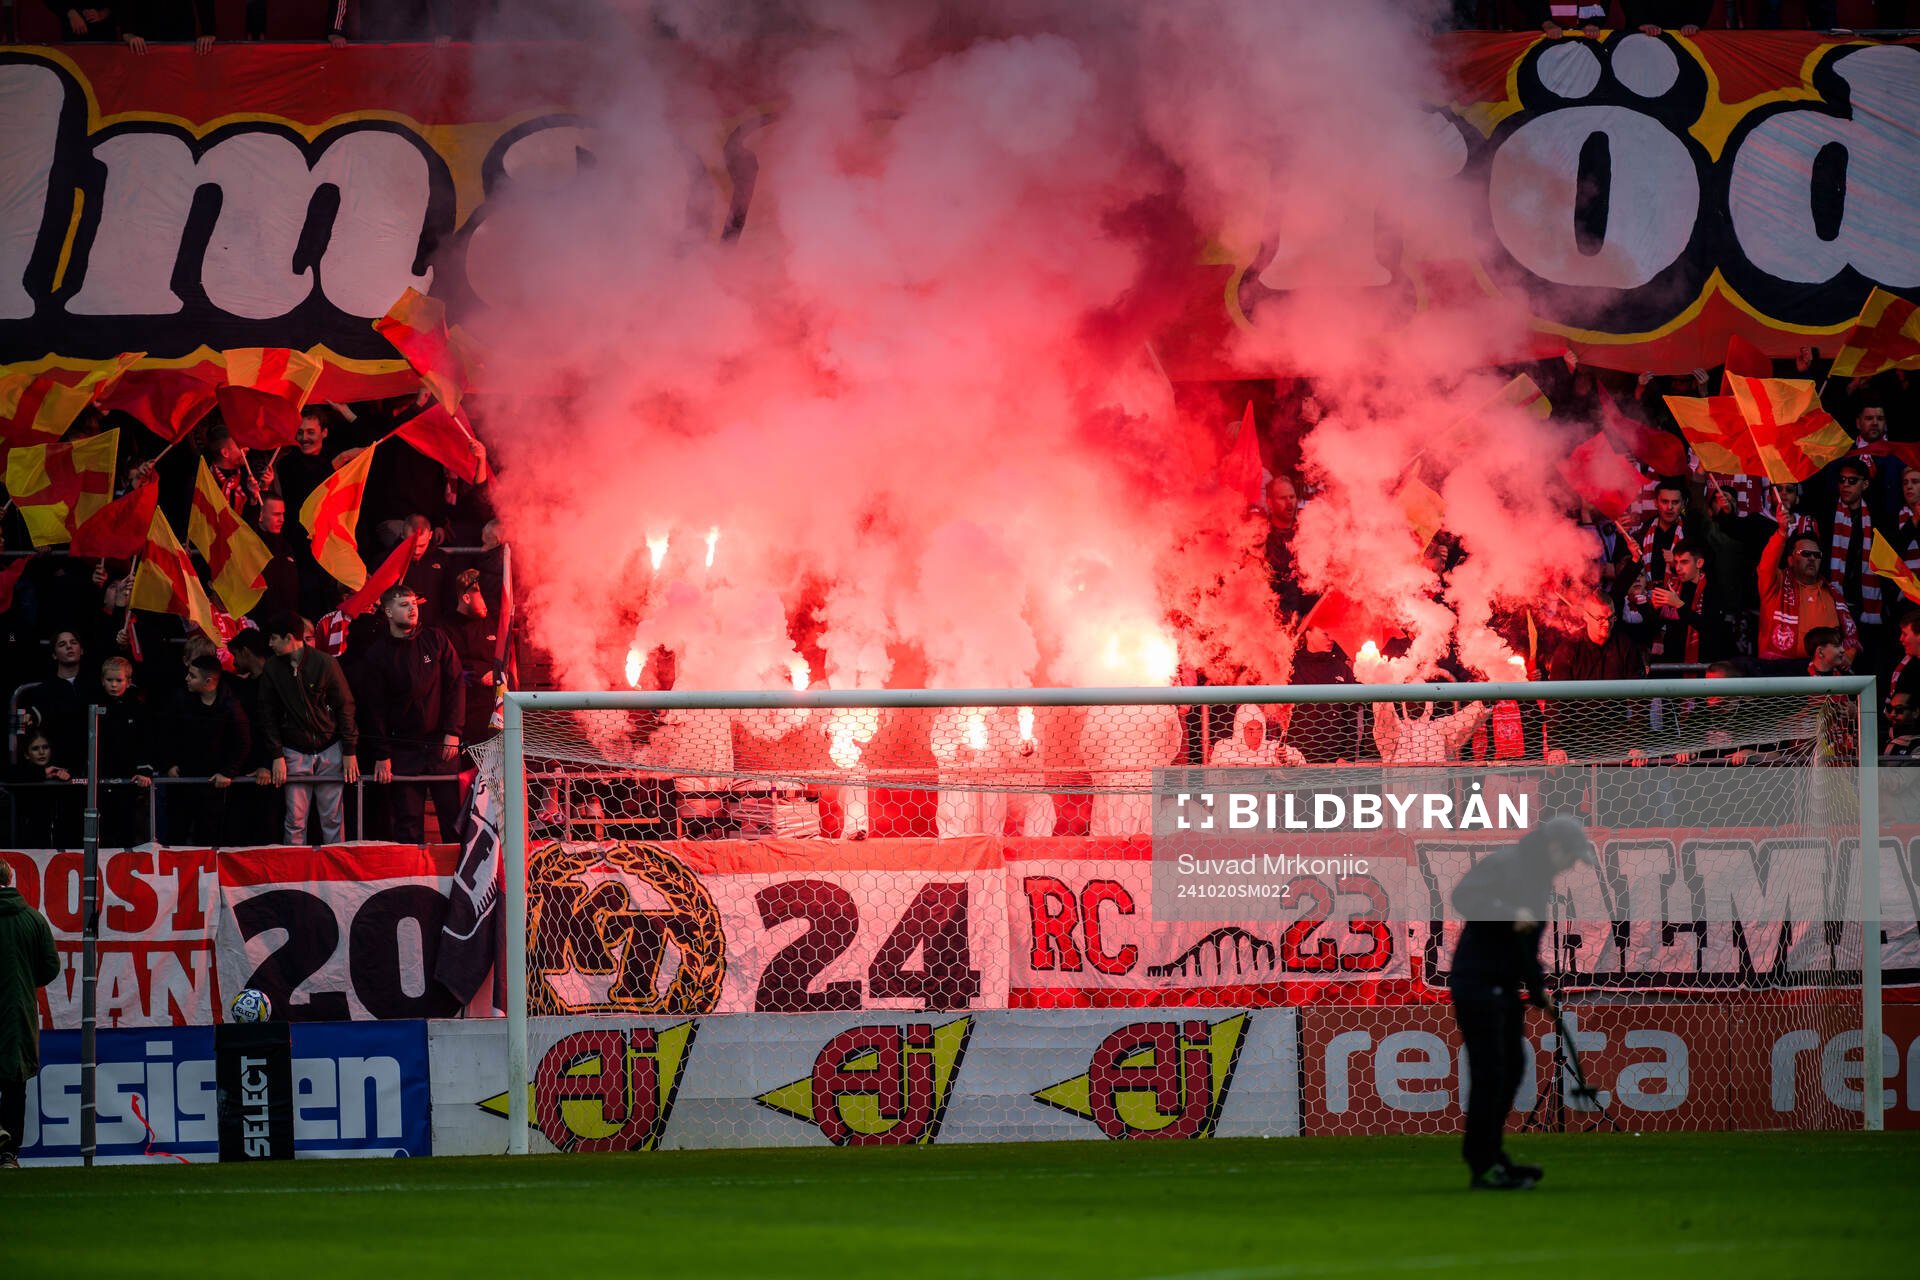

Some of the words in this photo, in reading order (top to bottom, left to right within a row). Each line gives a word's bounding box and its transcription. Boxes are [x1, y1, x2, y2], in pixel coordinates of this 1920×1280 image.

[232, 884, 455, 1020] 20
[755, 879, 981, 1013] 24
[1023, 875, 1139, 976] RC
[1280, 873, 1394, 974] 23
[38, 949, 212, 1030] VAN
[235, 1006, 256, 1018] SELECT
[240, 1055, 271, 1158] SELECT
[1771, 1029, 1920, 1113] re
